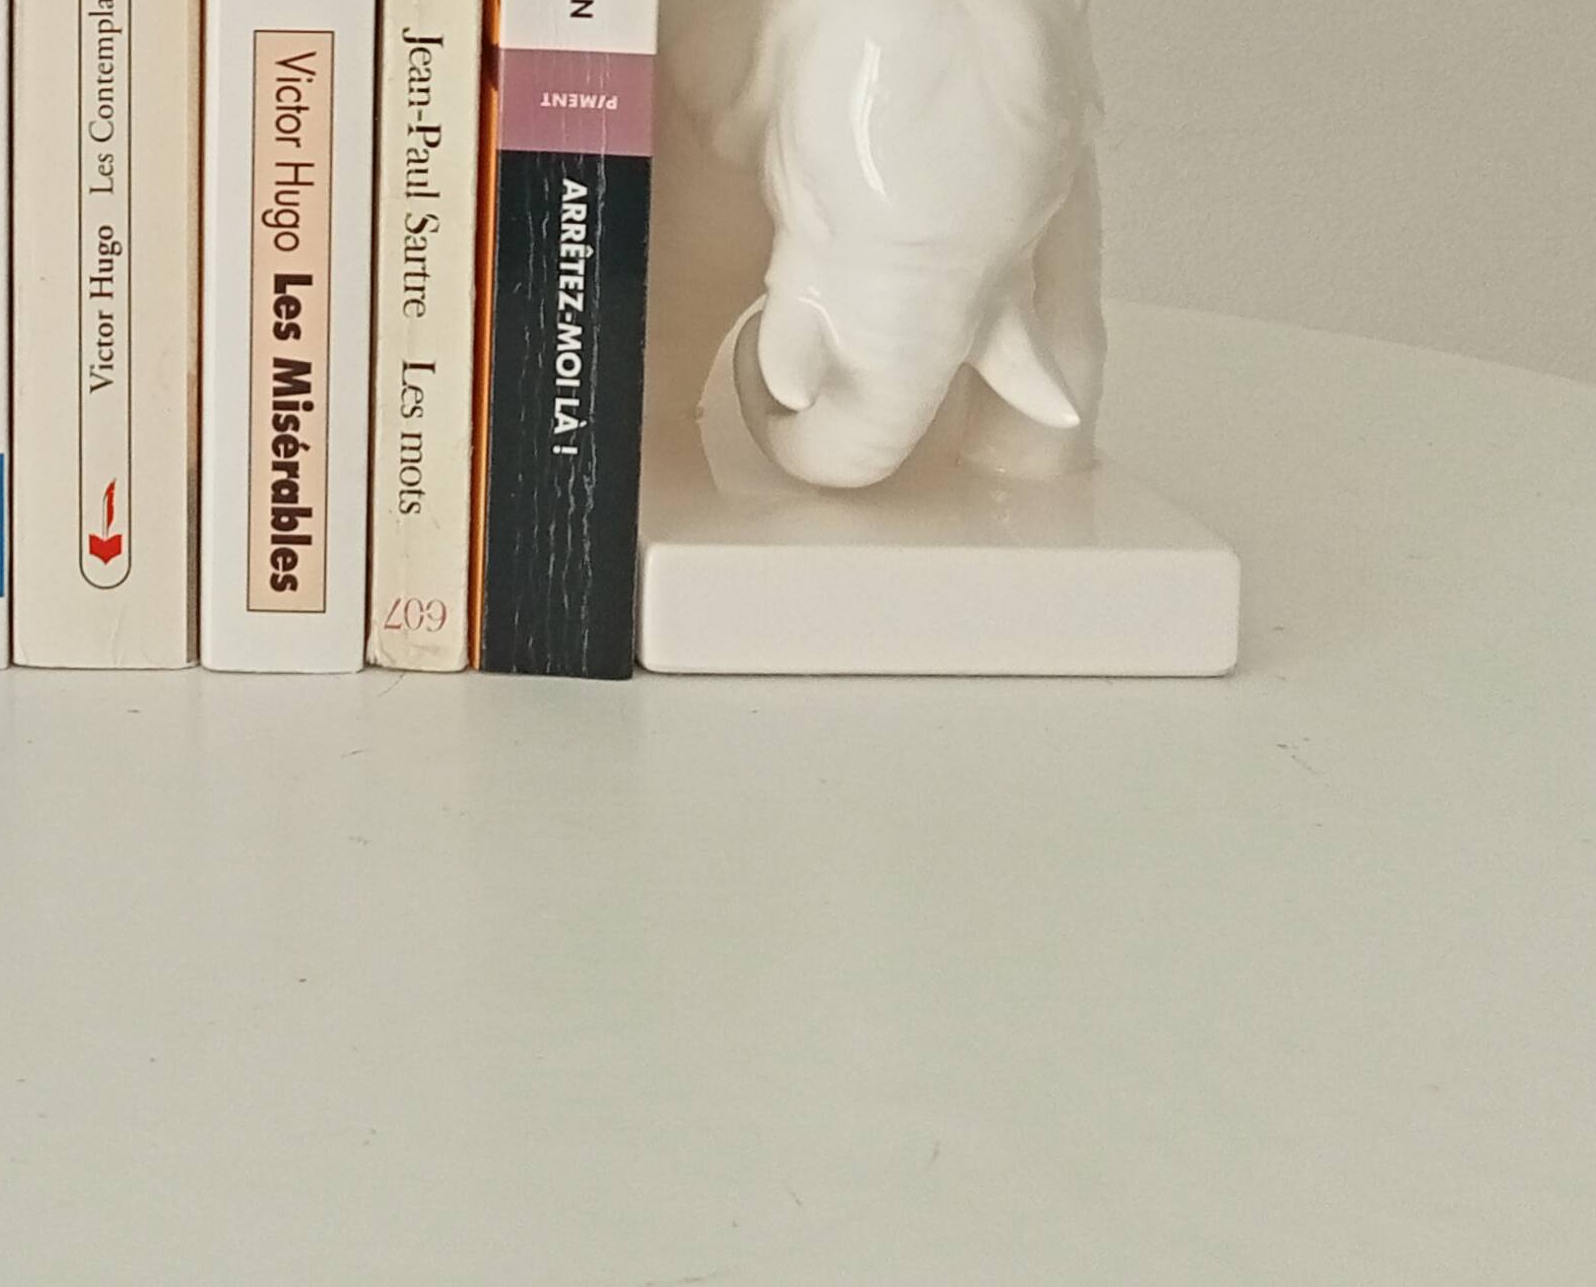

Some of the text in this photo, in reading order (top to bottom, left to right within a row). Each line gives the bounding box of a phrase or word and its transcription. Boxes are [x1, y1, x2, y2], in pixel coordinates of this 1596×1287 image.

[89, 152, 114, 195] Les
[89, 223, 122, 299] Hugo
[398, 26, 444, 515] Jean-Paul Sartre Les mots
[88, 309, 114, 395] Victor
[261, 50, 317, 593] Victor Hugo Les Misérables
[553, 177, 594, 457] ARRÊTEZ-MOI LÀ !
[384, 597, 446, 632] 607
